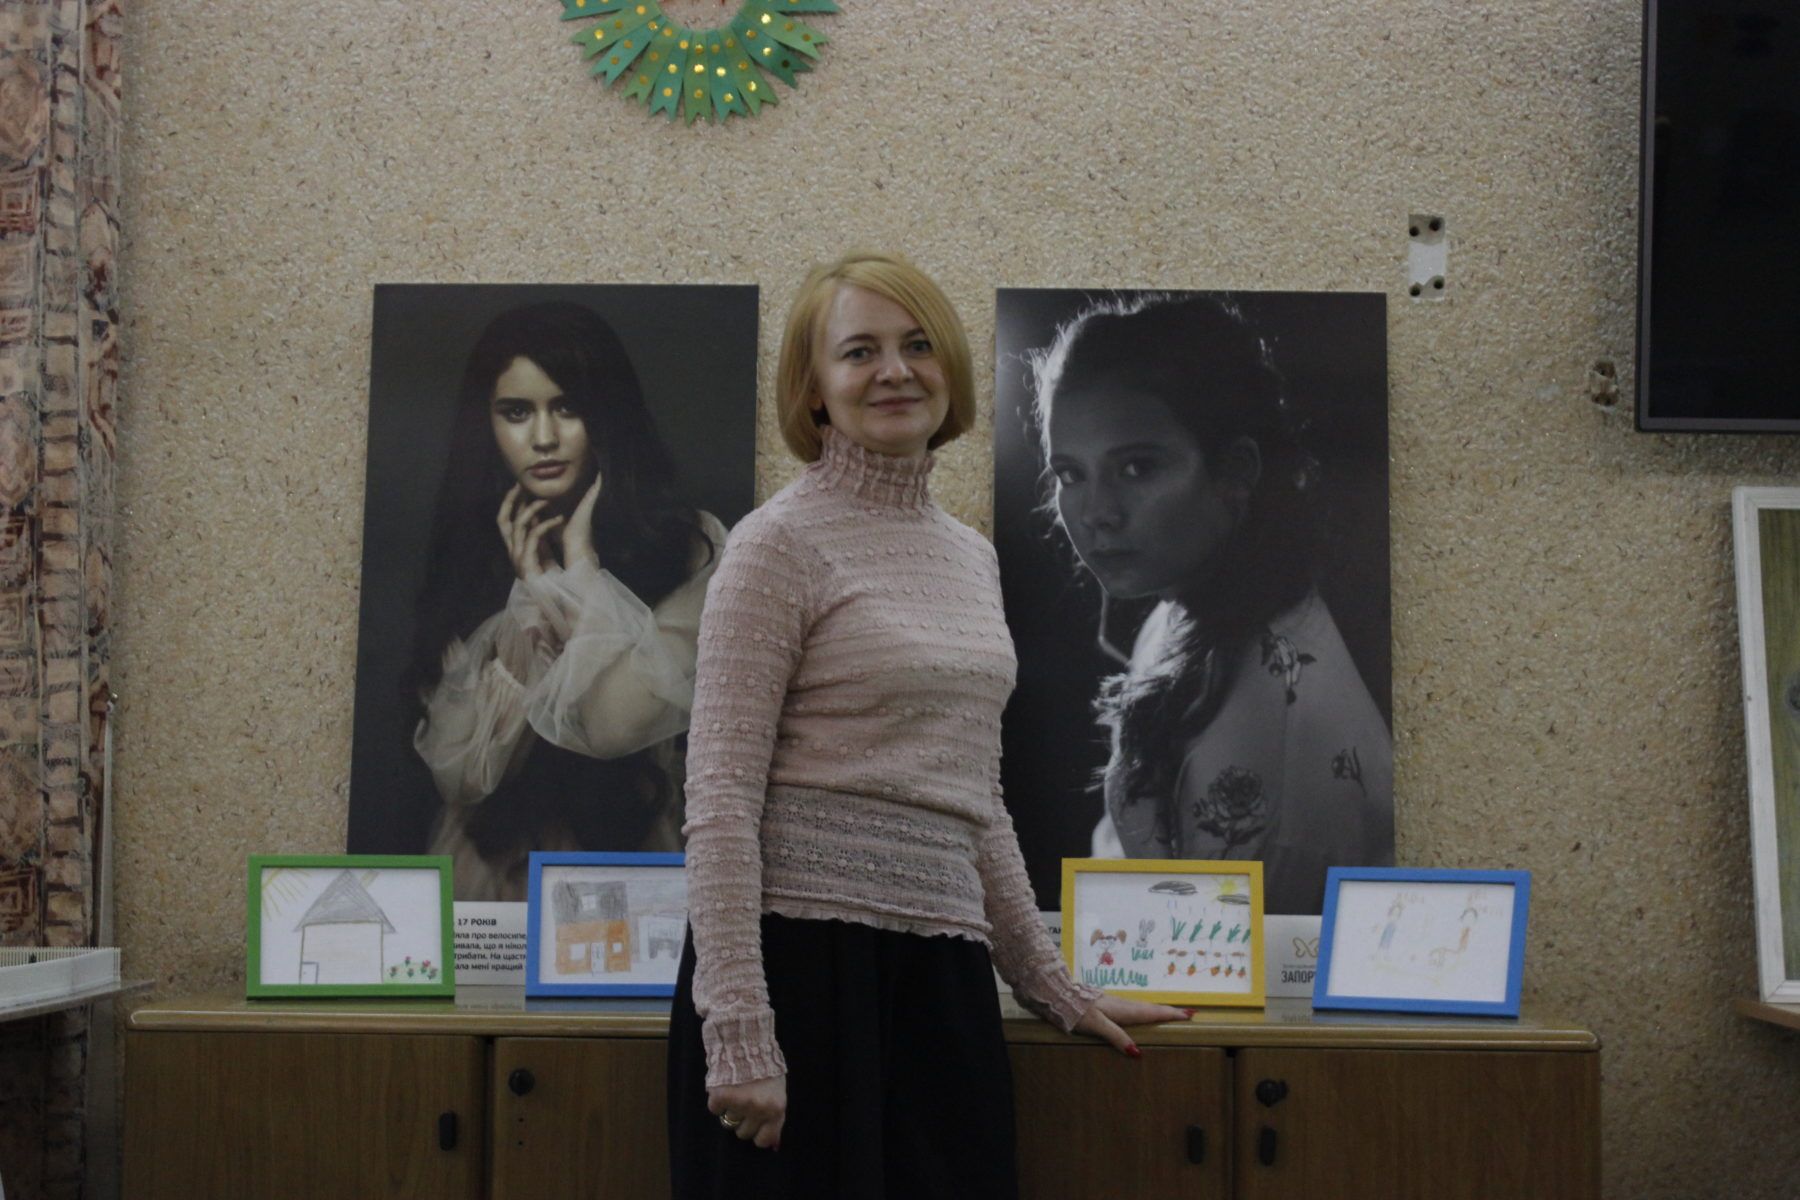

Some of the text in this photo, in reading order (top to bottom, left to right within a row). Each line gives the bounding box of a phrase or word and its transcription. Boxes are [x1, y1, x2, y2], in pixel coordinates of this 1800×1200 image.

[458, 918, 497, 926] 17 РОКІВ
[471, 932, 487, 940] про
[471, 962, 489, 970] мені
[491, 963, 523, 971] кращий
